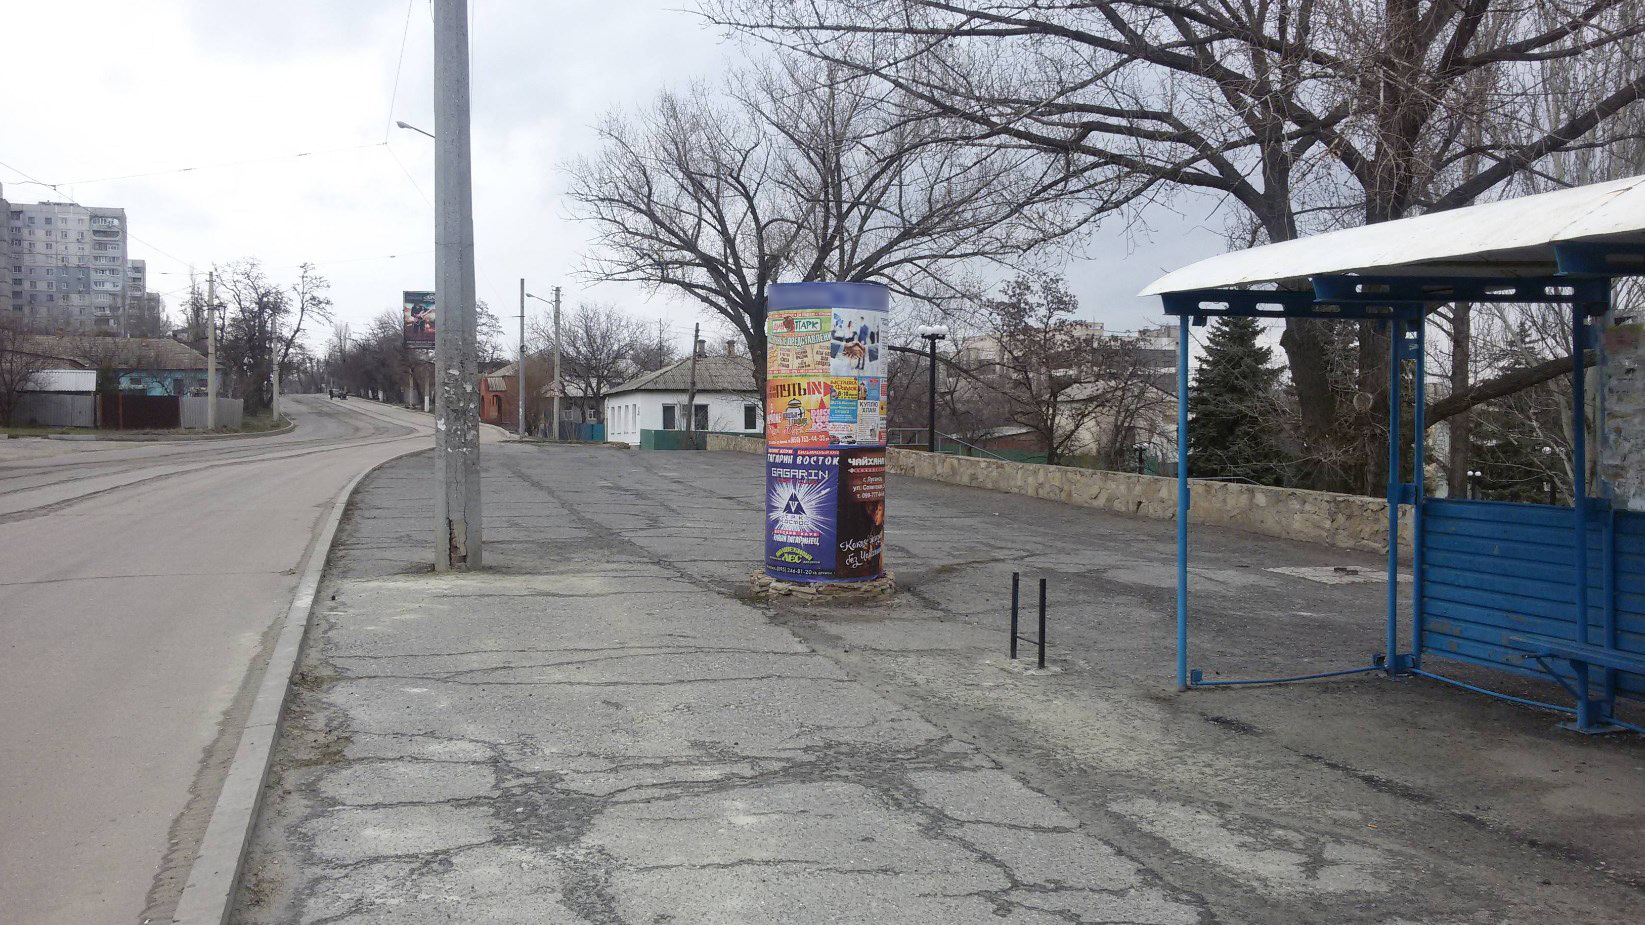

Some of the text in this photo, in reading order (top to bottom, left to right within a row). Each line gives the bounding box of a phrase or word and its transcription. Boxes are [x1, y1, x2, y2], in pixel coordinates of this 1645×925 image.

[767, 453, 840, 466] ГАГАРИН ВОСТОК
[771, 467, 828, 480] GAGARIN
[781, 552, 802, 564] ЛЕС
